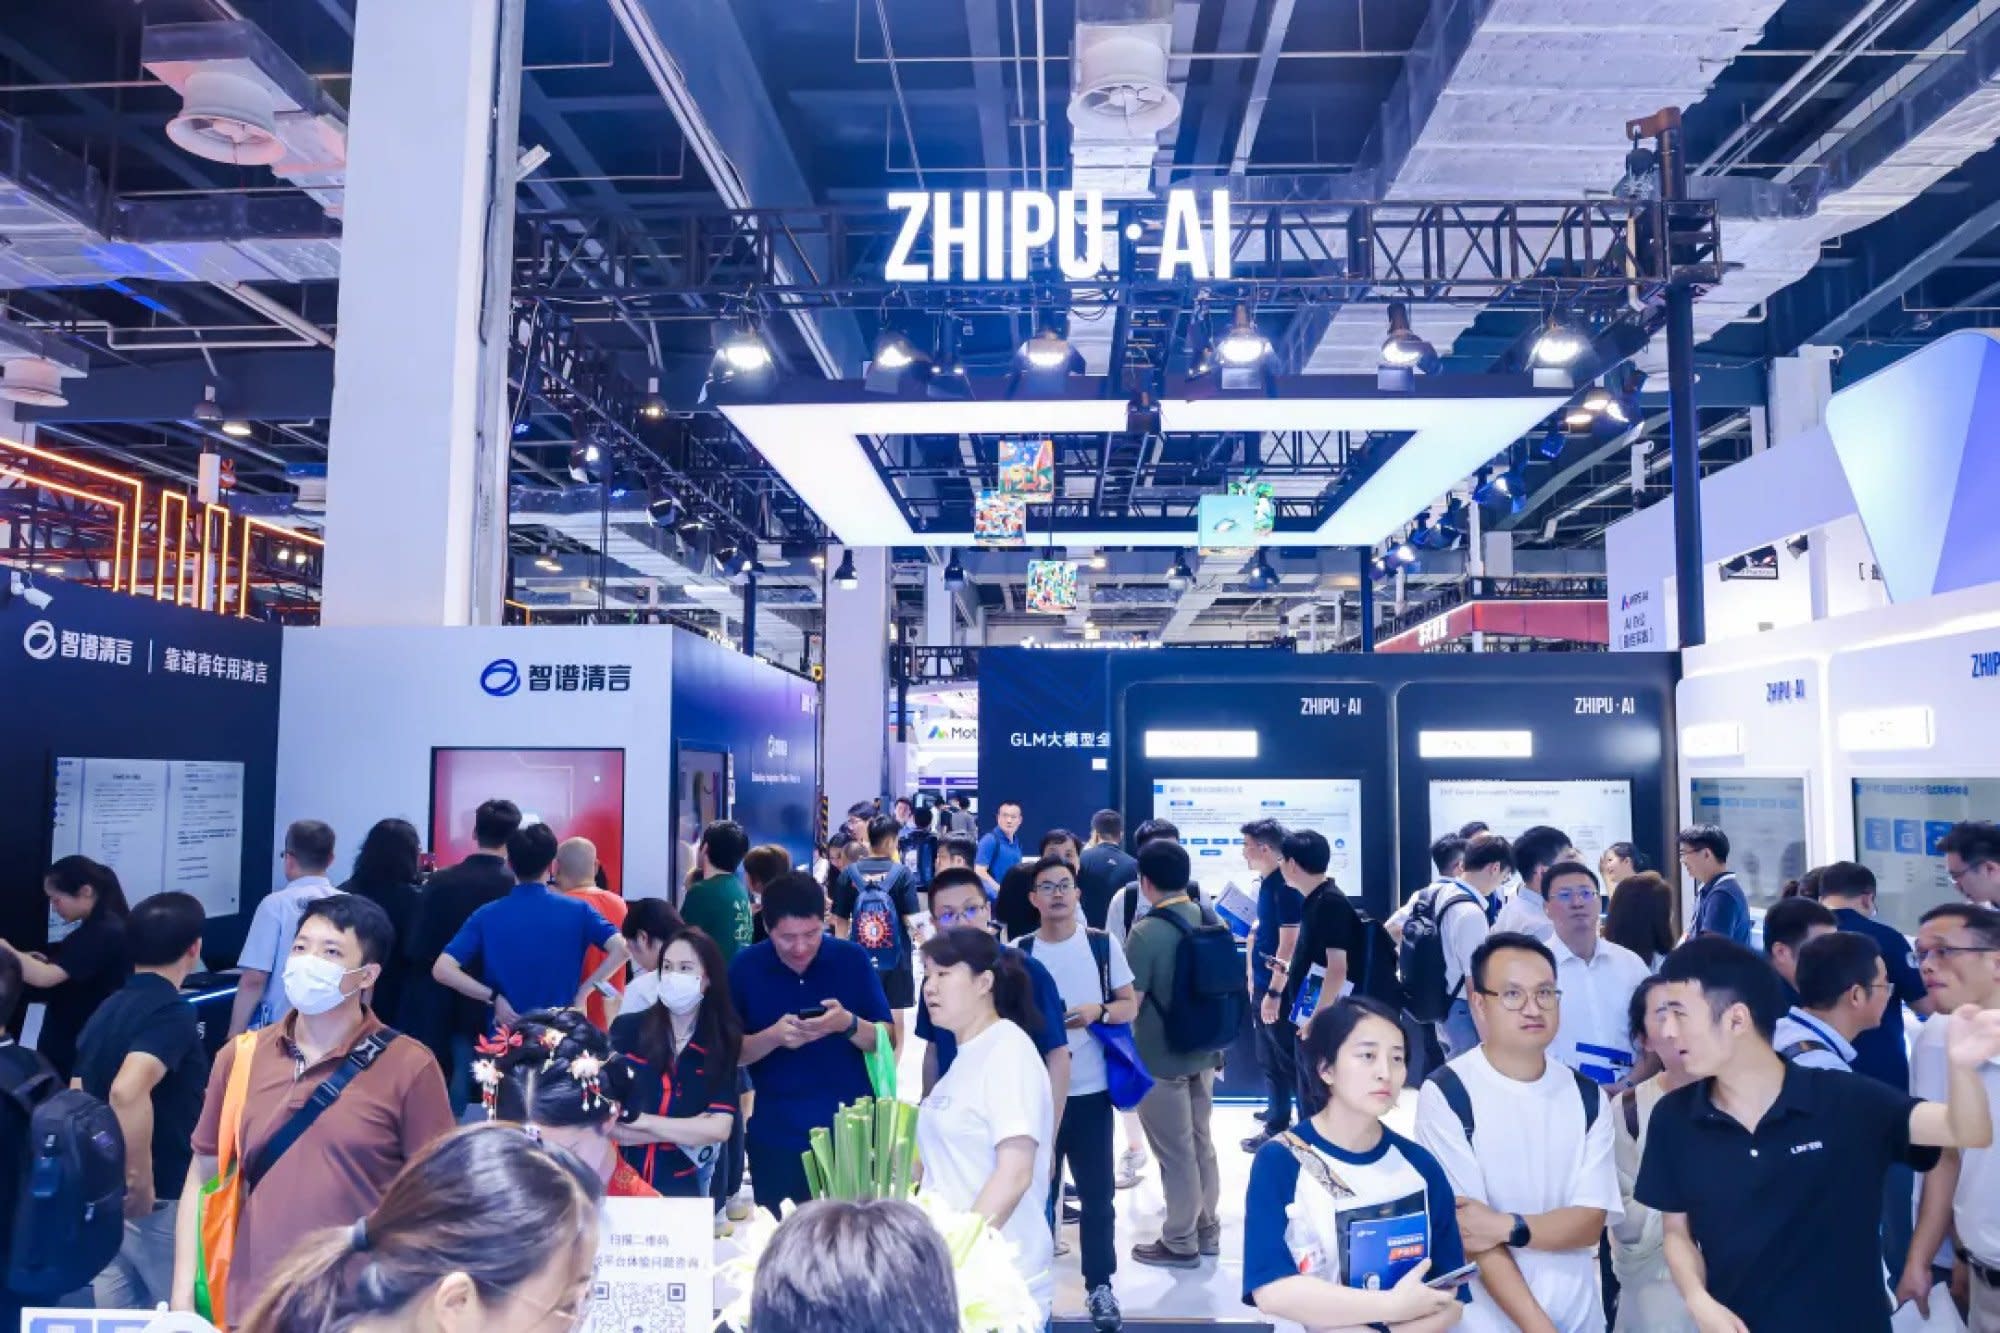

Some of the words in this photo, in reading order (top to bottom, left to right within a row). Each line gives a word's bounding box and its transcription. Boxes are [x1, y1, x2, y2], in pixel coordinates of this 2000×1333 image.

[60, 629, 134, 665] 智谱清言
[163, 647, 268, 684] 靠谱青年用清言
[528, 664, 632, 692] 智谱清言
[609, 1233, 670, 1248] 扫描二维码
